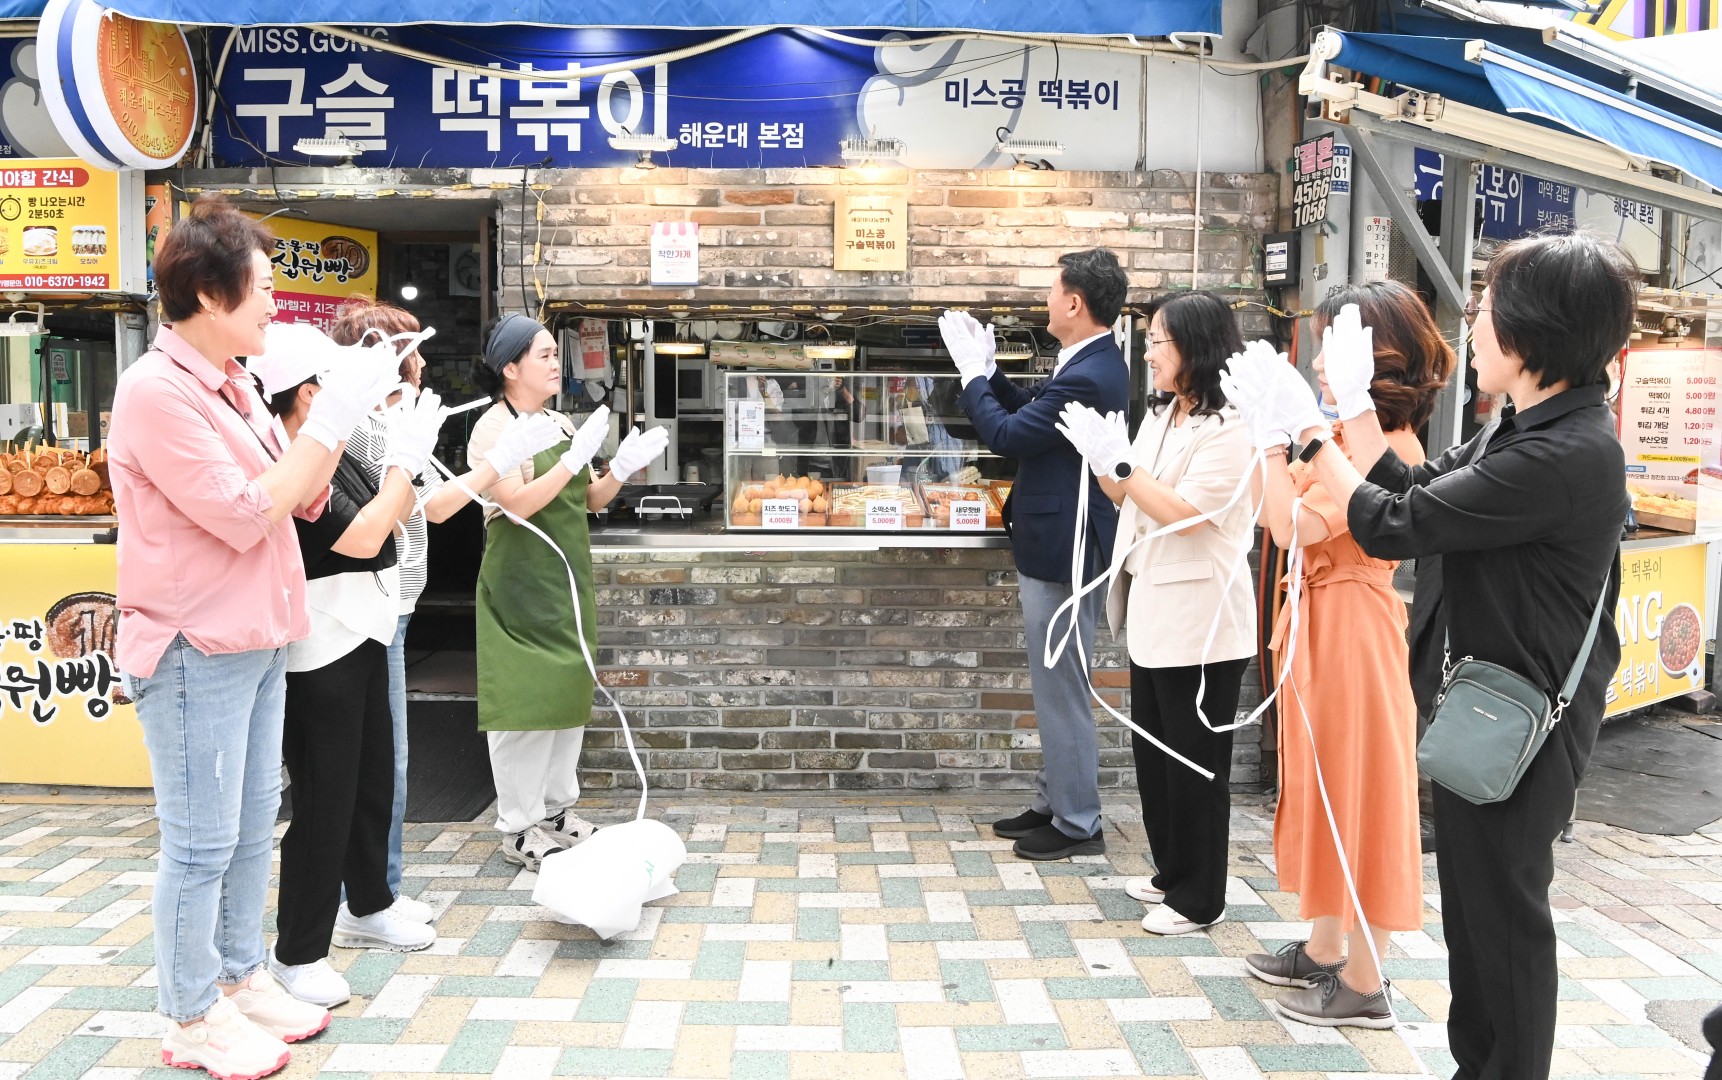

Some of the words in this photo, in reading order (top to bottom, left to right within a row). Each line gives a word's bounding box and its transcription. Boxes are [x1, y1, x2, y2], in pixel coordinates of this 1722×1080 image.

[944, 79, 1026, 108] 미스공
[1038, 80, 1120, 110] 떡볶이
[235, 63, 394, 152] 구슬
[432, 62, 668, 152] 떡볶이
[679, 122, 748, 148] 해운대
[757, 122, 804, 148] 본점
[1300, 137, 1333, 174] 결혼
[0, 170, 37, 187] 야할
[42, 170, 74, 186] 간식
[1334, 166, 1346, 178] 01
[1294, 177, 1330, 206] 4566
[1538, 181, 1553, 199] 마약
[1556, 185, 1570, 204] 김밥
[28, 197, 37, 208] 빵
[40, 196, 85, 207] 나오는시간
[28, 209, 64, 219] 2분50초
[1294, 199, 1327, 227] 1058
[1614, 198, 1637, 220] 해운대
[1639, 203, 1654, 224] 본점
[855, 229, 885, 238] 미스공
[845, 240, 895, 250] 구슬떡볶이
[271, 251, 353, 282] 십원빵
[24, 276, 105, 287] 010-6370-1942
[1635, 377, 1671, 385] 구슬떡볶이
[1648, 392, 1671, 400] 떡볶이
[1640, 407, 1656, 415] 튀김
[1657, 407, 1670, 415] 4개
[1638, 421, 1652, 429] 튀김
[1654, 421, 1669, 429] 개당
[1639, 436, 1669, 444] 부산오뎅
[1631, 557, 1662, 582] 떡볶이
[1622, 651, 1660, 697] 떡볶이
